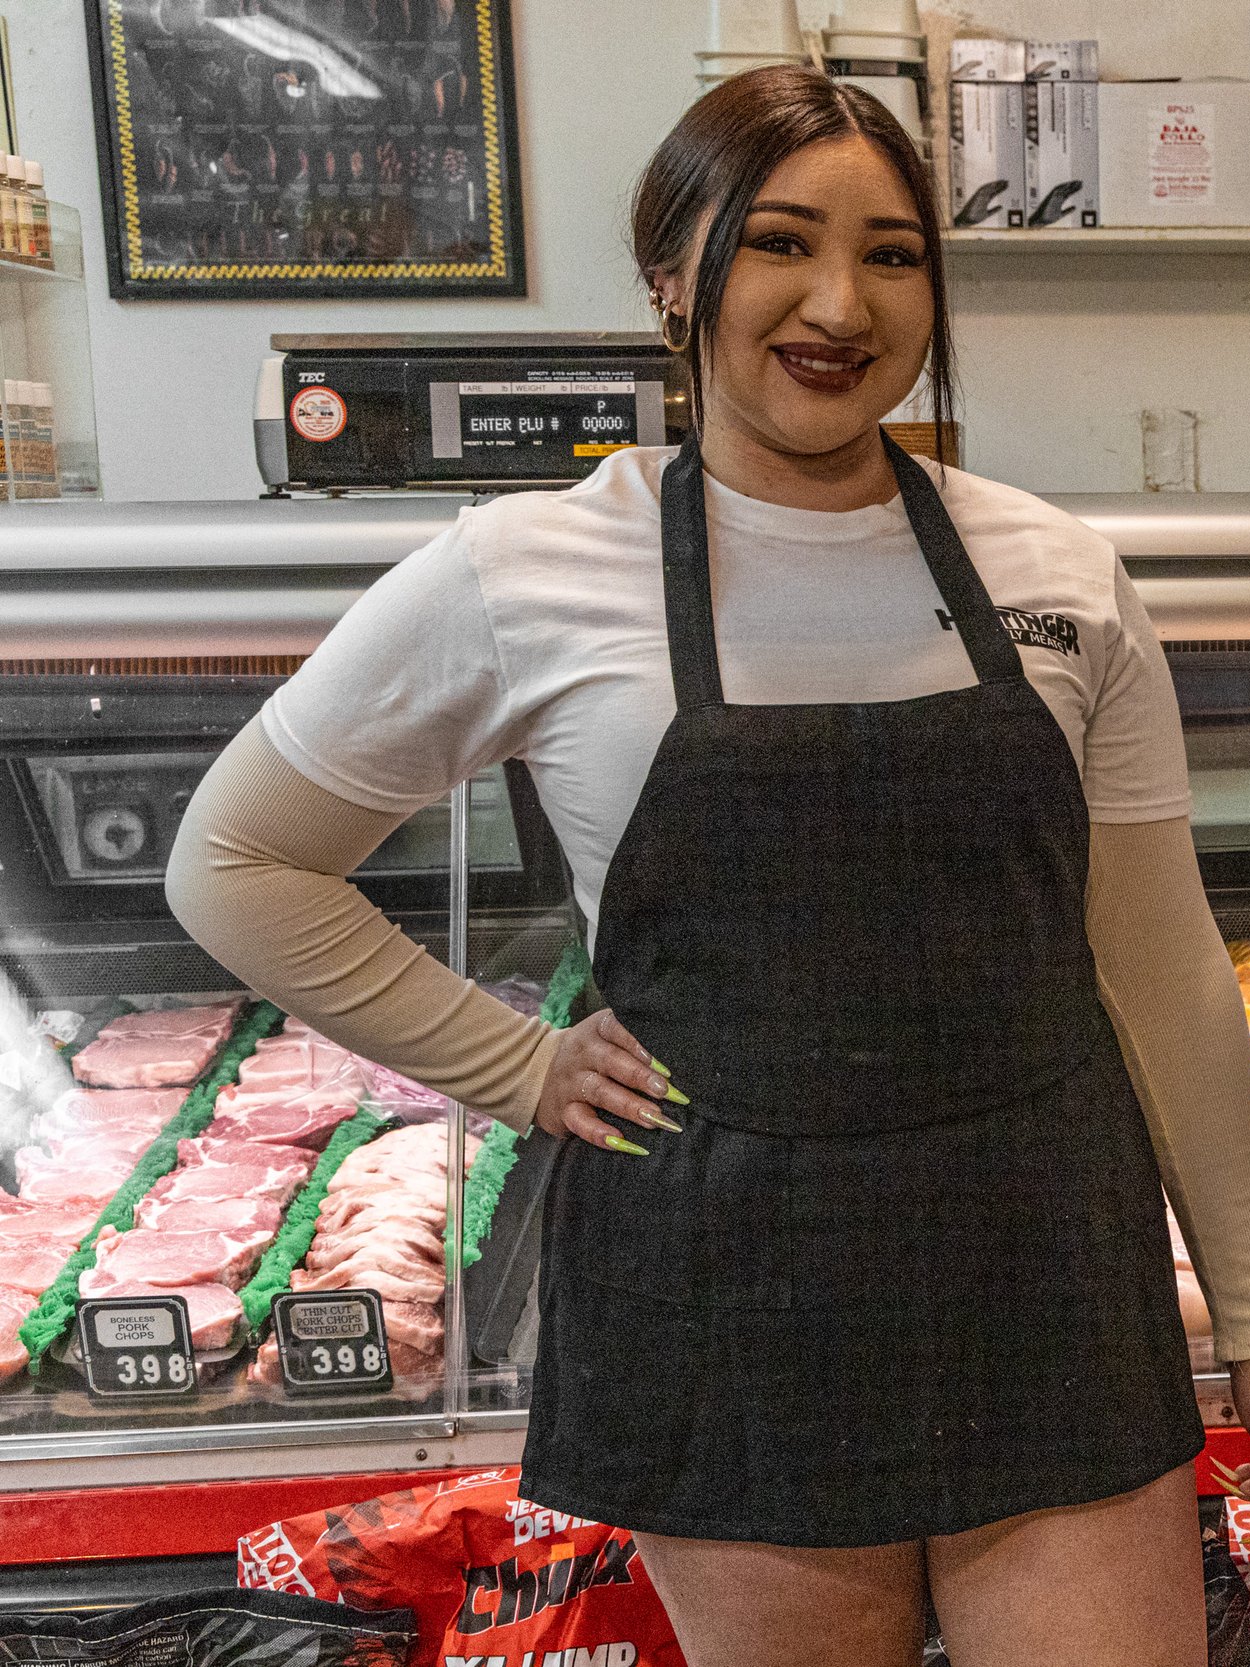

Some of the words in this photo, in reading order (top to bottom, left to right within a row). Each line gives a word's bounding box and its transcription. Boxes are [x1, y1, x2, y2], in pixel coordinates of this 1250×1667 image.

[299, 372, 325, 383] TEC
[501, 384, 508, 392] lb
[515, 384, 546, 392] WEIGHT
[560, 384, 567, 392] lb
[597, 400, 606, 413] P
[470, 418, 512, 432] ENTER
[518, 417, 544, 433] PLU
[551, 417, 560, 431] #
[1030, 632, 1065, 653] MEATS
[301, 1307, 327, 1317] THIN
[330, 1306, 352, 1316] CUT
[110, 1316, 155, 1324] BONELESS
[297, 1317, 324, 1327] PORK
[326, 1314, 362, 1325] CHOPS
[117, 1323, 150, 1332] PORK
[341, 1324, 363, 1334] CUT
[115, 1331, 155, 1341] CHOPS
[150, 1634, 184, 1646] HAZARD
